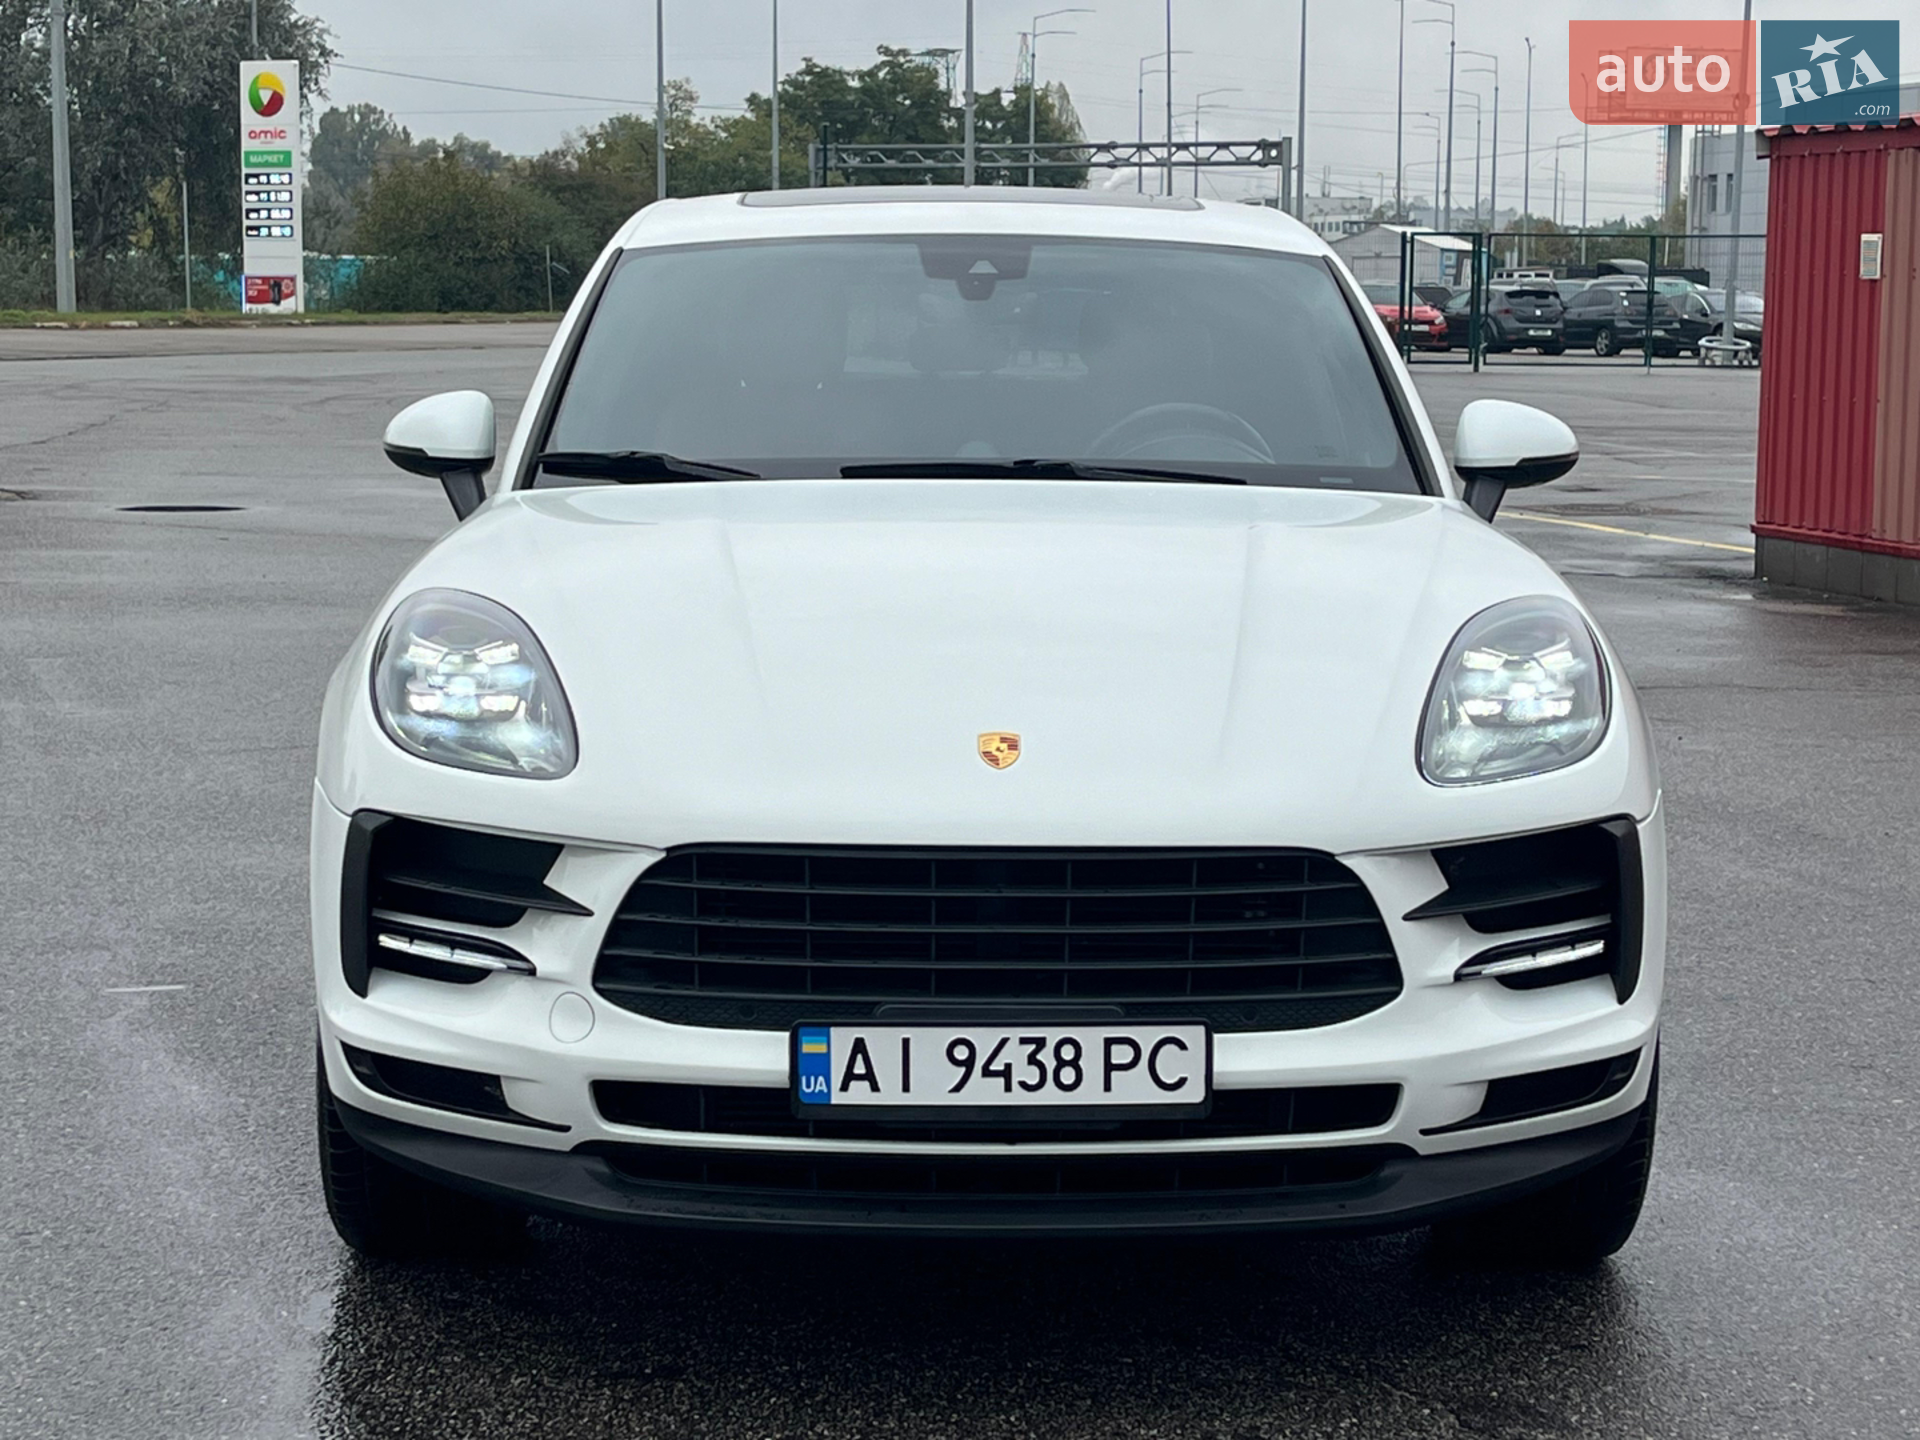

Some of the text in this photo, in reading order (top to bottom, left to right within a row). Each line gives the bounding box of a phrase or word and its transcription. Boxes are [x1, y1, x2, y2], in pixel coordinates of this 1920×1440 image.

[248, 127, 287, 139] amic
[946, 1037, 1083, 1093] 9438
[1103, 1036, 1188, 1093] PC
[802, 1076, 827, 1093] UA
